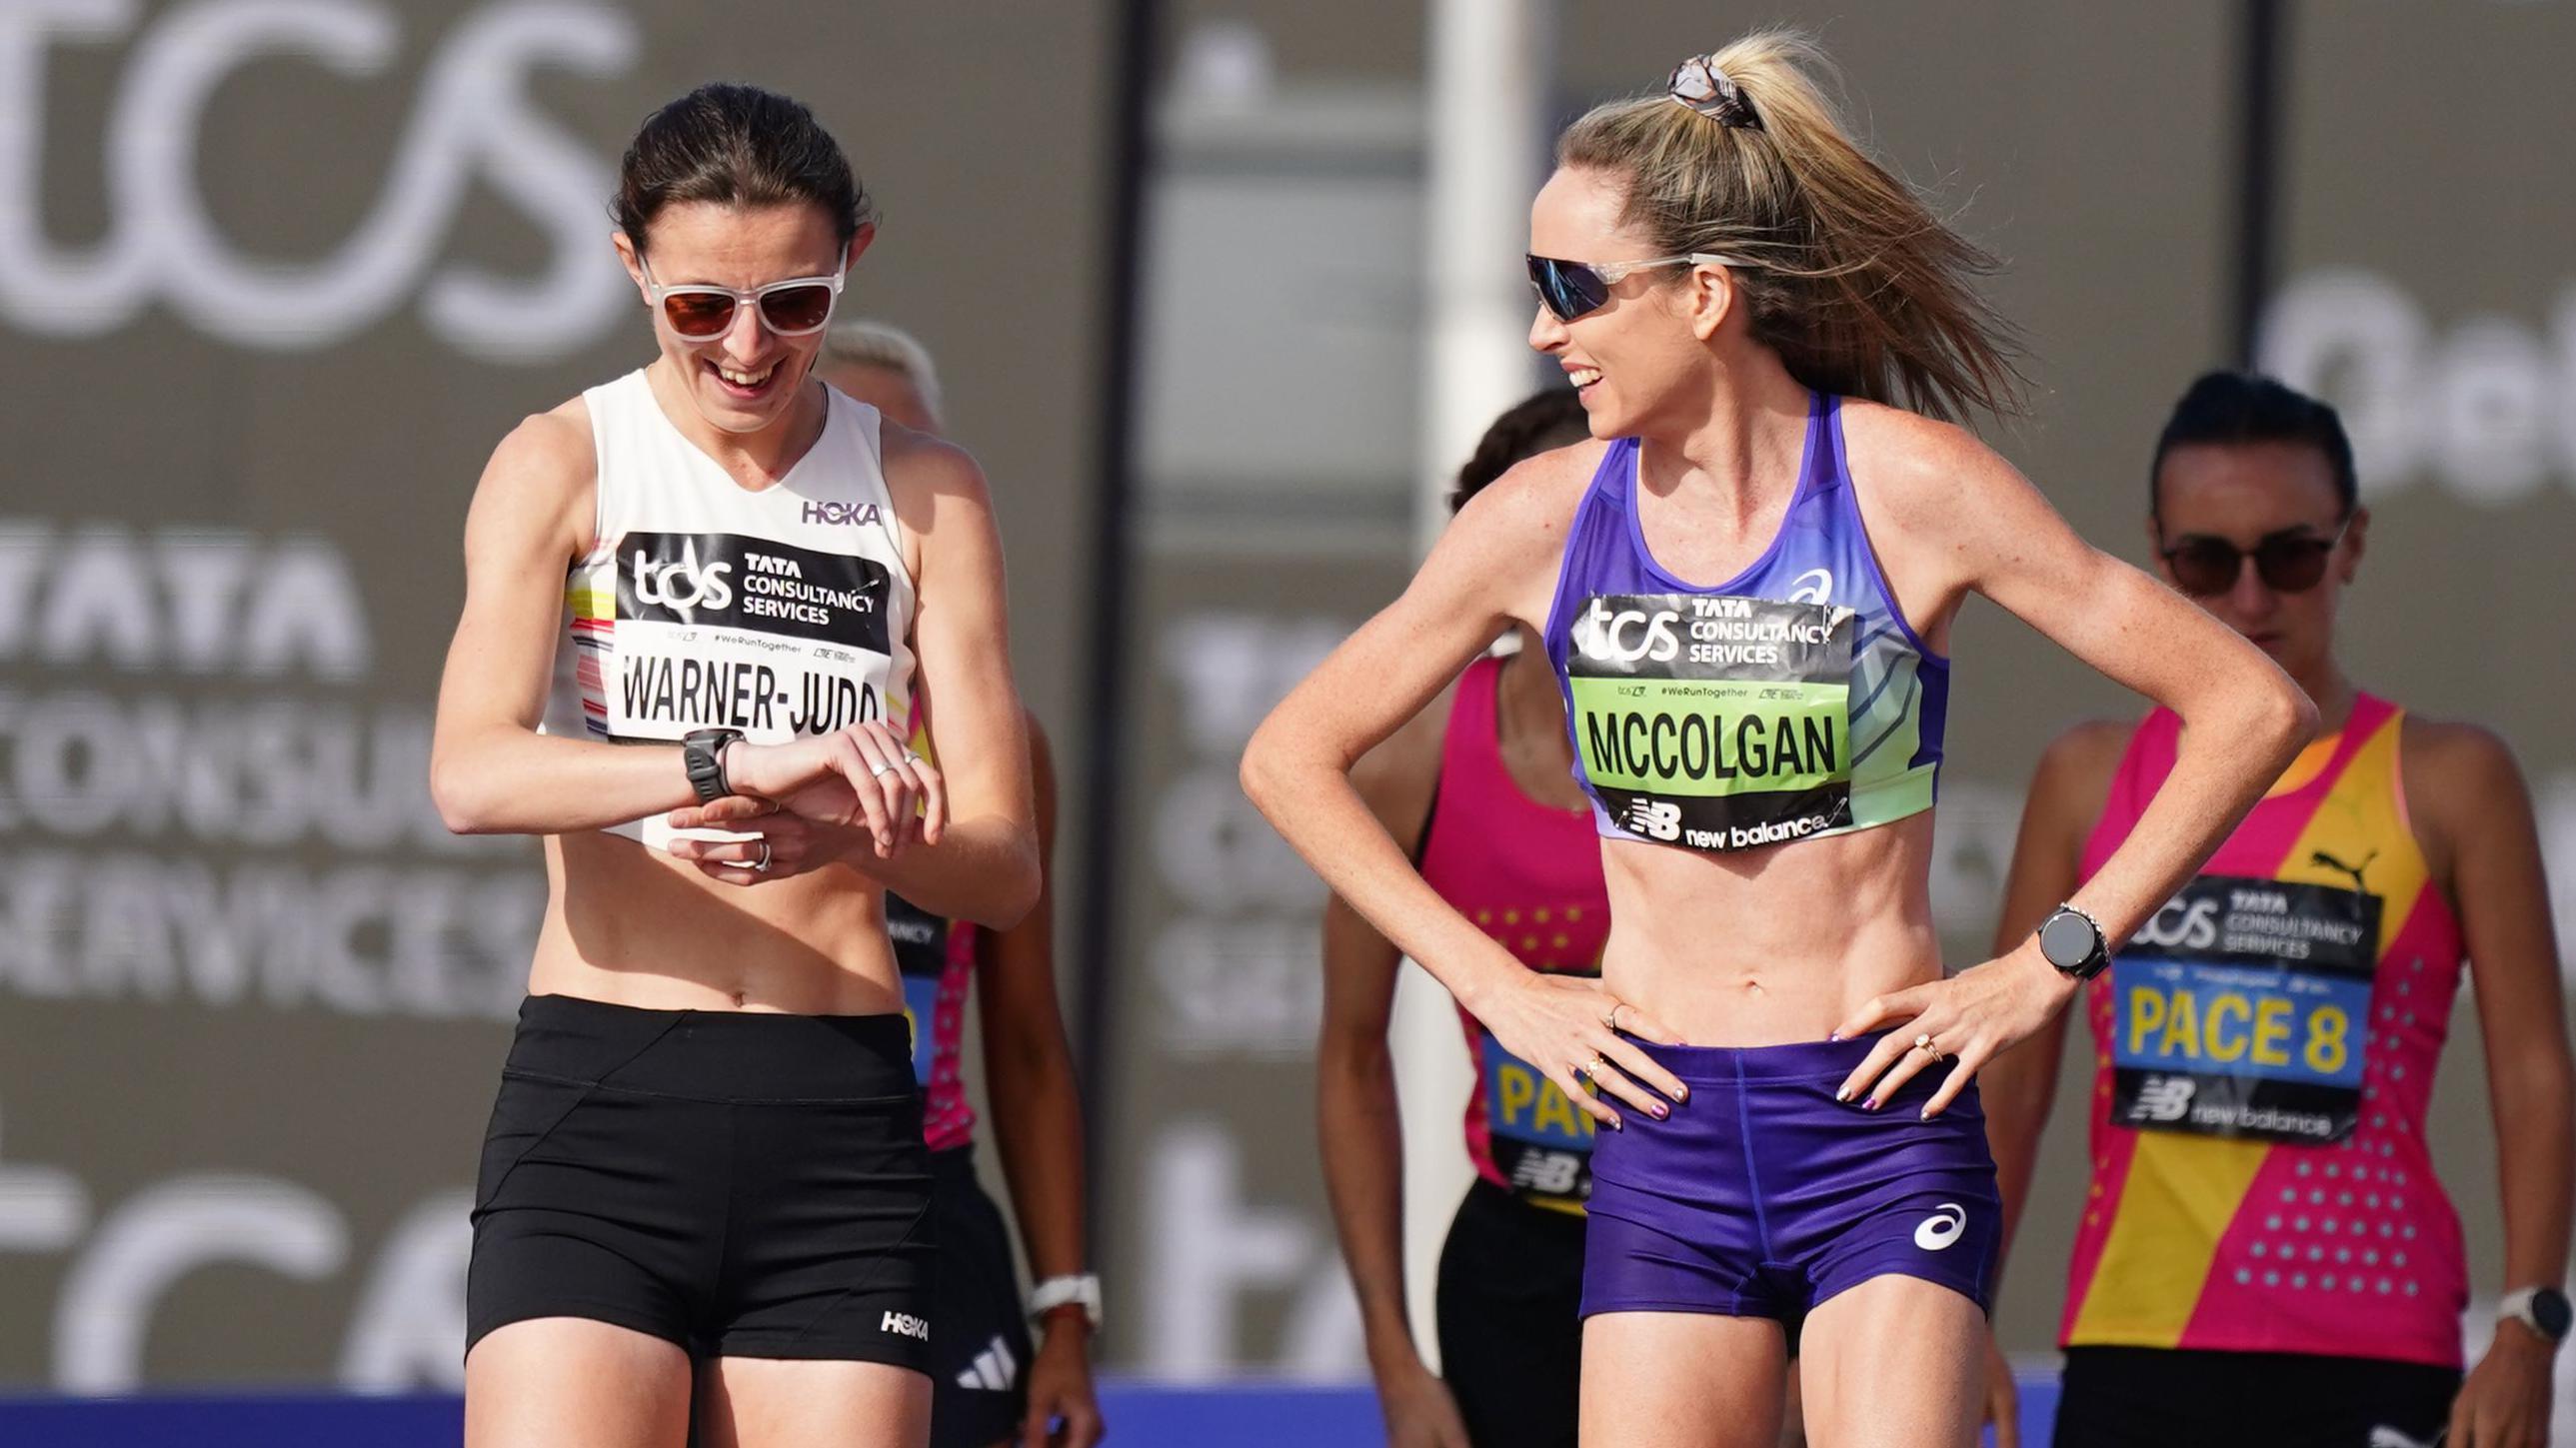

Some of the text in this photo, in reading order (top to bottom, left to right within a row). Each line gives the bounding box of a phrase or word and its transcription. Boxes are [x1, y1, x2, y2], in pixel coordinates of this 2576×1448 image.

[802, 501, 883, 527] HOKA
[744, 553, 802, 579] TATA
[743, 575, 875, 614] CONSULTANCY
[1691, 599, 1752, 619] TATA
[743, 597, 830, 626] SERVICES
[1689, 622, 1833, 645] CONSULTANCY
[1689, 645, 1778, 664] SERVICES
[624, 655, 878, 735] WARNER-JUDD
[1661, 687, 1747, 699] #WeRunTogether
[1586, 711, 1837, 781] MCCOLGAN
[1685, 828, 1727, 848] new
[1731, 814, 1826, 847] balance
[0, 849, 548, 1019] ERVICES
[2129, 897, 2218, 949] cs
[2225, 912, 2364, 944] CONSULTANCY
[2128, 984, 2348, 1075] PACE 8
[881, 1310, 929, 1342] HOKA
